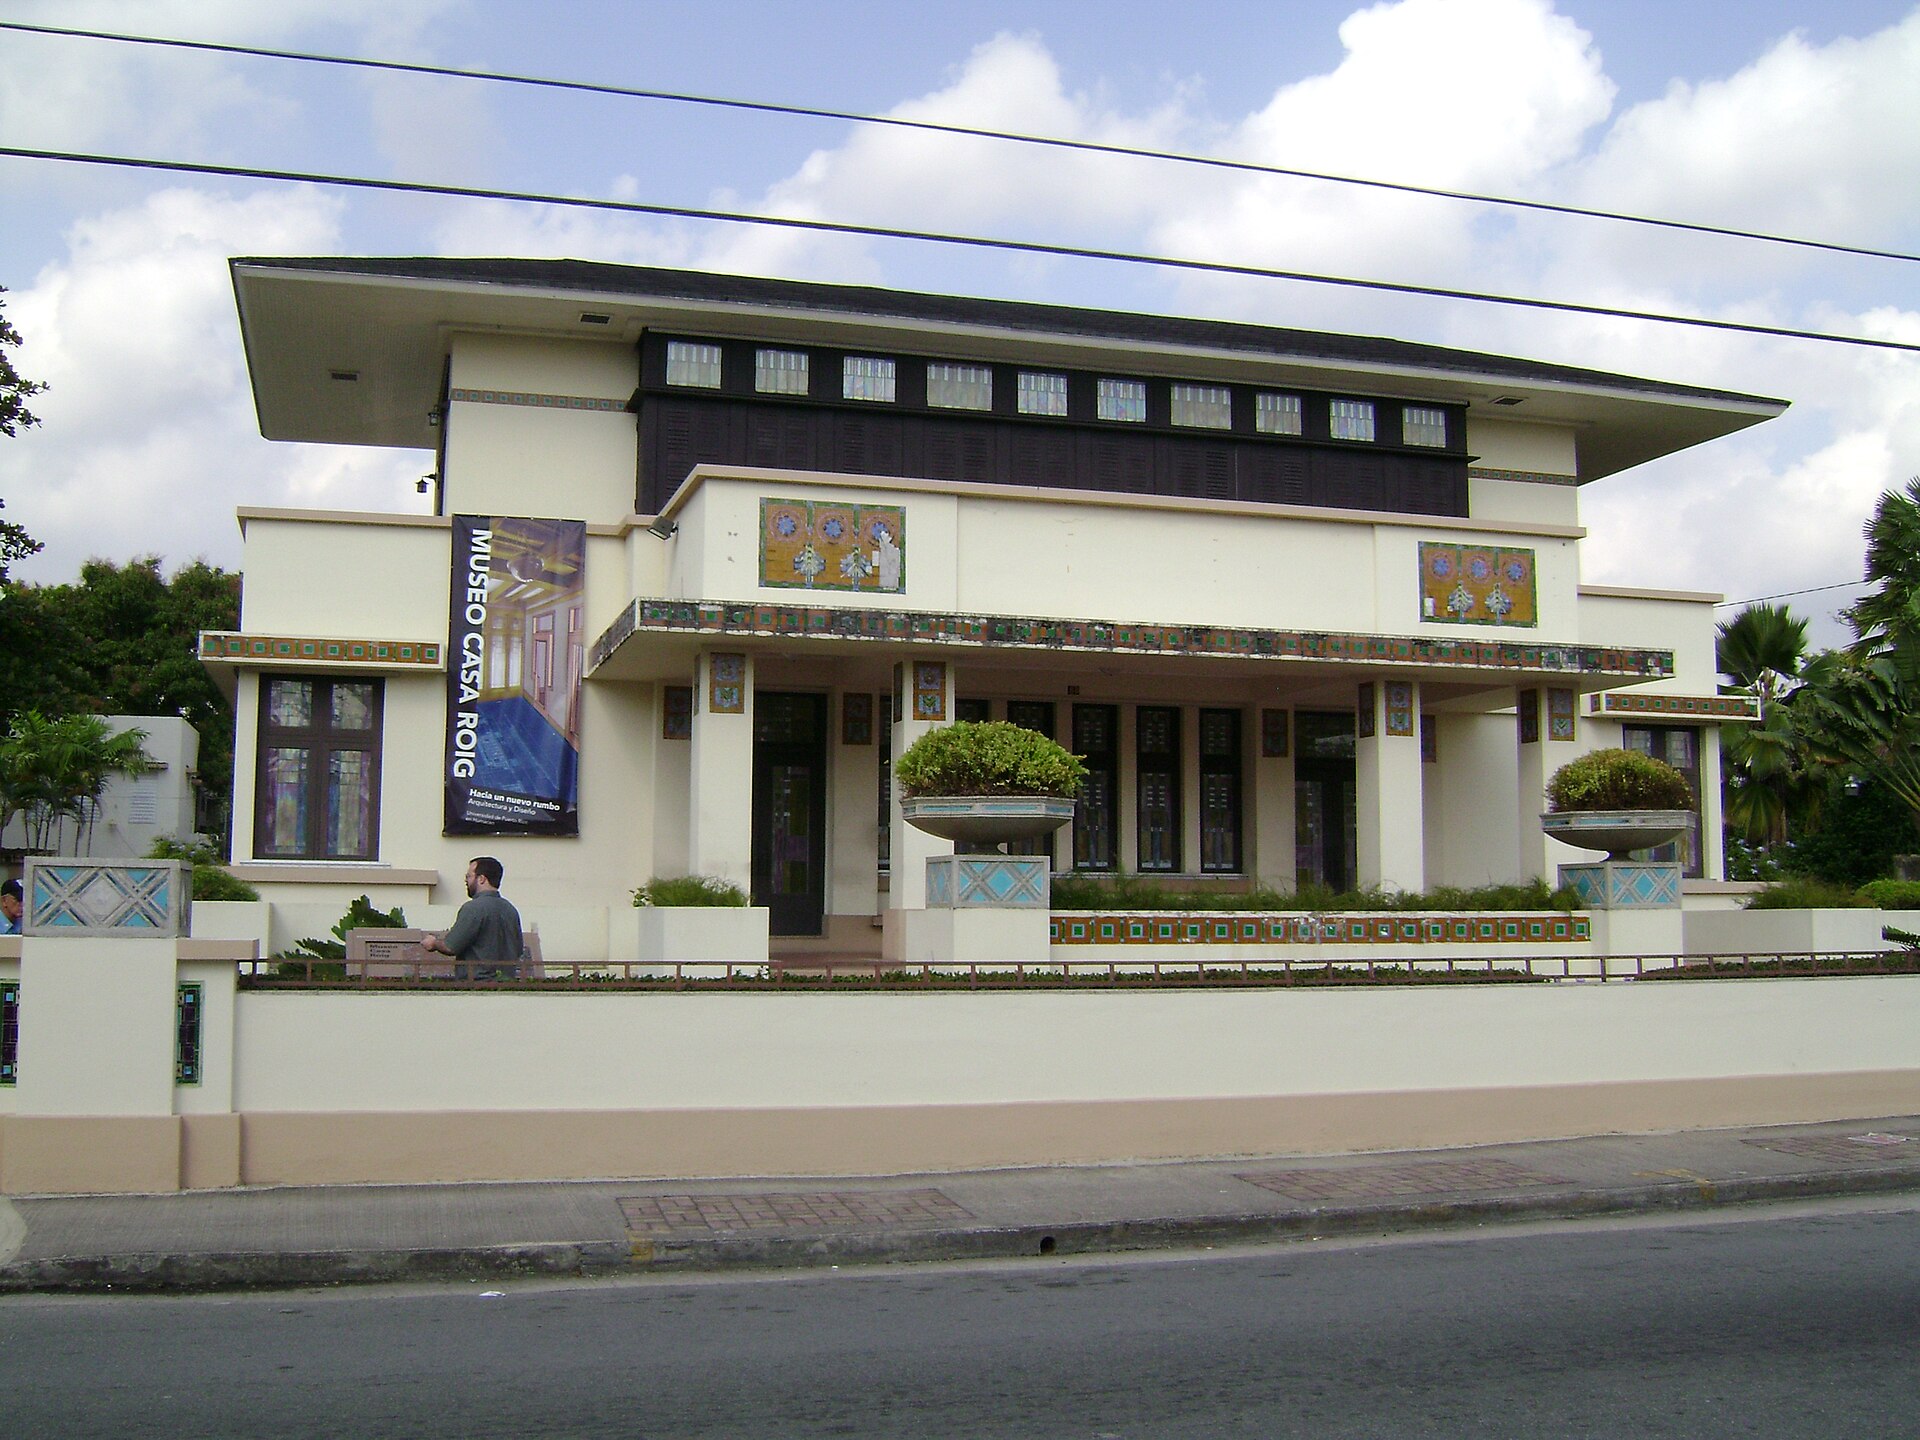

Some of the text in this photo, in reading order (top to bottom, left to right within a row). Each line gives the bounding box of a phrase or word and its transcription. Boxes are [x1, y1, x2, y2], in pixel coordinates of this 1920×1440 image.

[453, 528, 493, 778] MUSEO CASA ROIG
[468, 798, 508, 811] Arquitectura
[513, 805, 536, 815] Diseño
[469, 788, 560, 811] Hacia un nuevo rumbo
[466, 810, 494, 819] Universidad
[501, 815, 518, 823] Puerto
